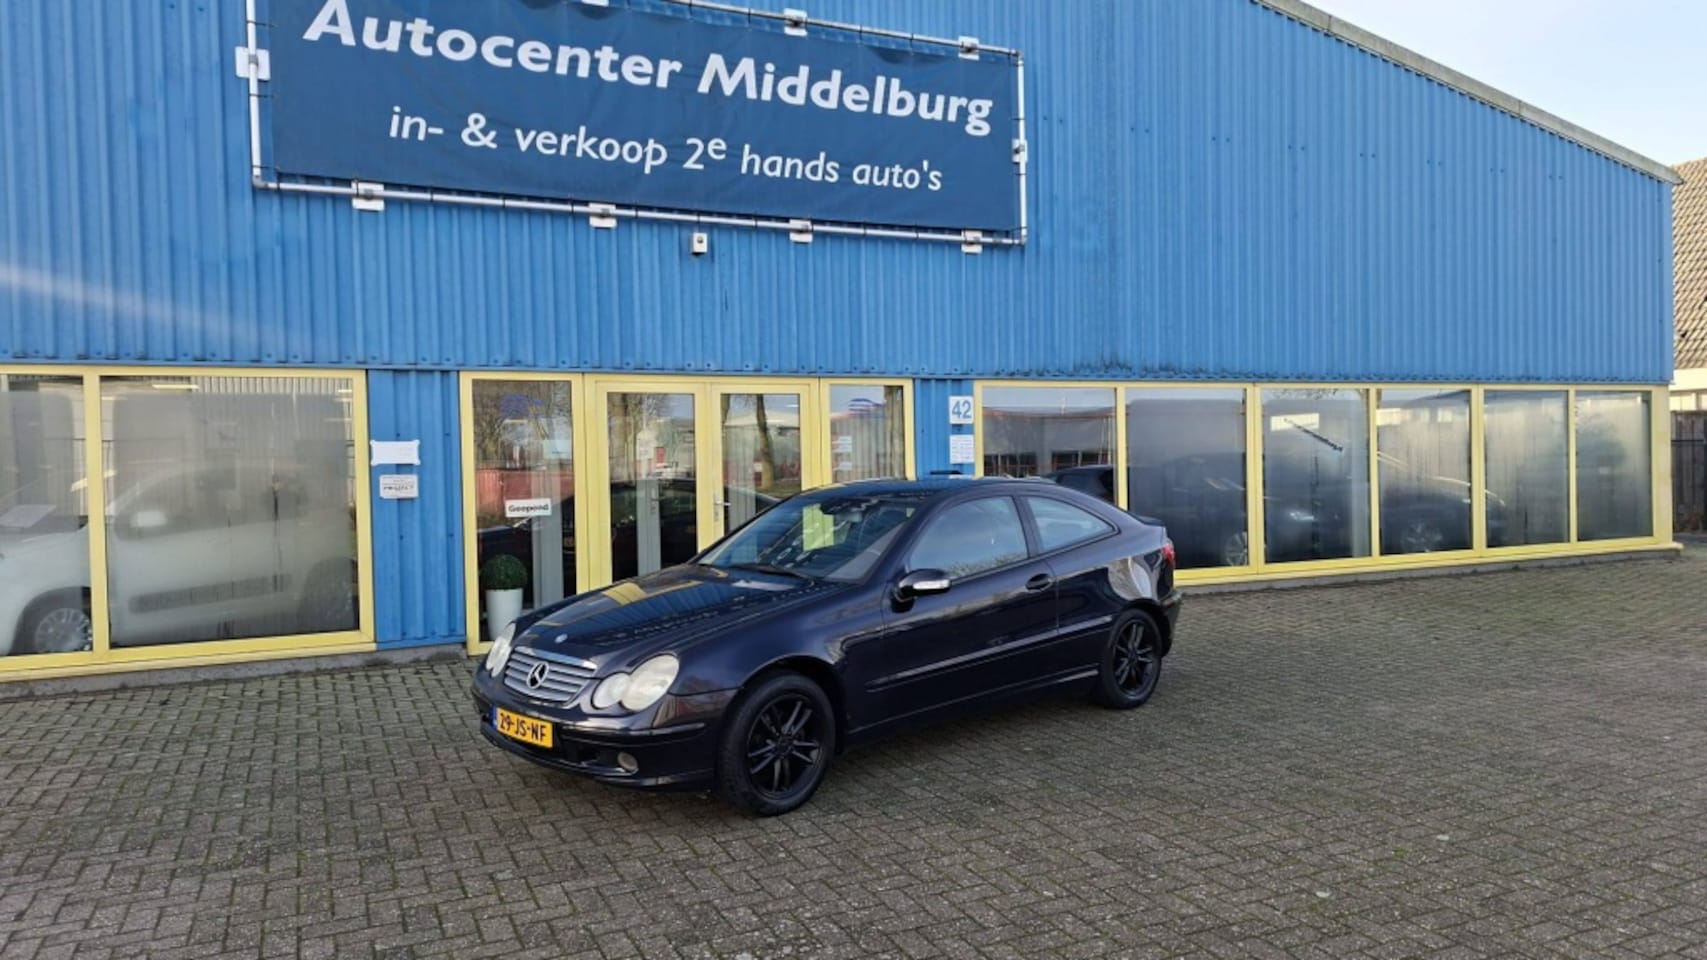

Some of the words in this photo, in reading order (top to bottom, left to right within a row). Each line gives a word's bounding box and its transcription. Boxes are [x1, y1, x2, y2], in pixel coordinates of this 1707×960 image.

[303, 0, 682, 89] Autocenter
[697, 53, 993, 136] Middelburg
[389, 106, 444, 141] in-
[461, 112, 498, 149] &
[514, 125, 667, 175] verkoop
[741, 144, 840, 184] hands
[852, 159, 942, 191] auto's
[952, 400, 972, 419] 42
[500, 712, 547, 742] 29-JS-NF
